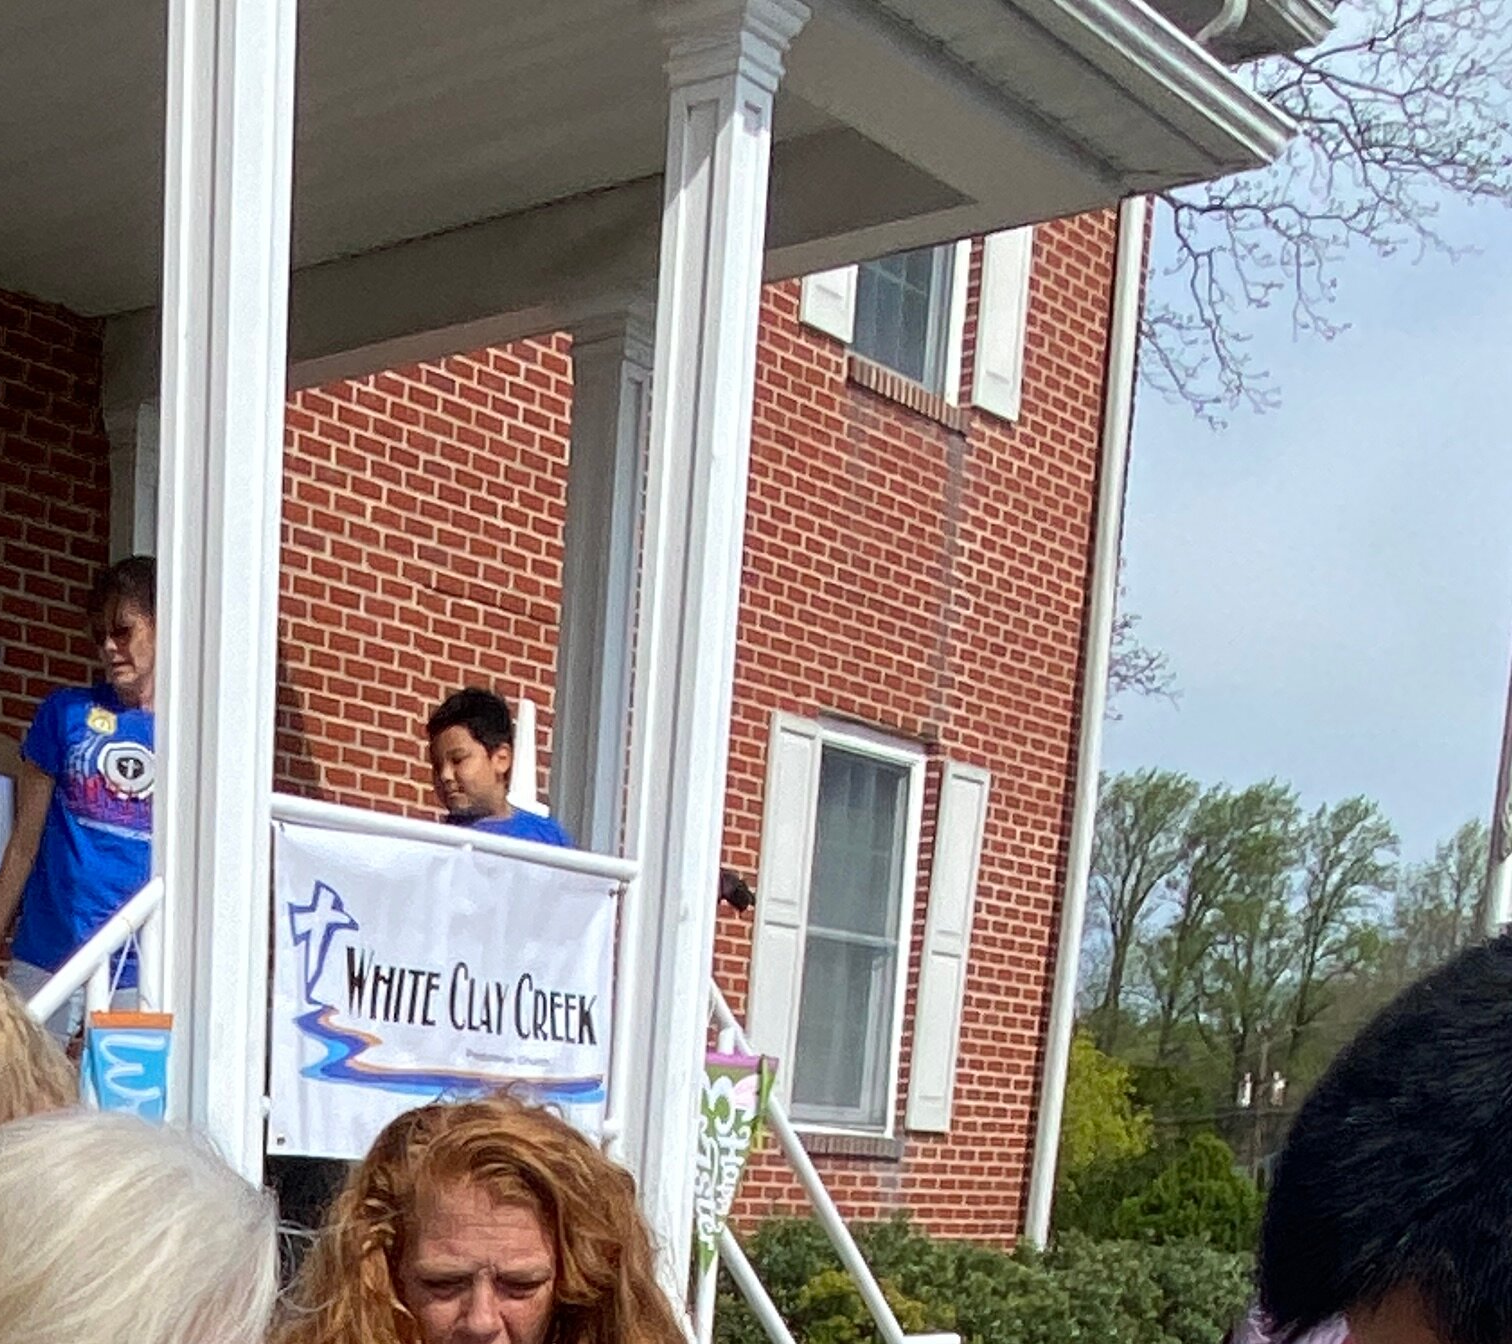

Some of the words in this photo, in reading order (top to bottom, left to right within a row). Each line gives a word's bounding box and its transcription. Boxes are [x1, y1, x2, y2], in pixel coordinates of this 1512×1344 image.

[346, 946, 441, 1026] WHITE
[449, 962, 510, 1035] CLAY
[515, 973, 598, 1045] CREEK
